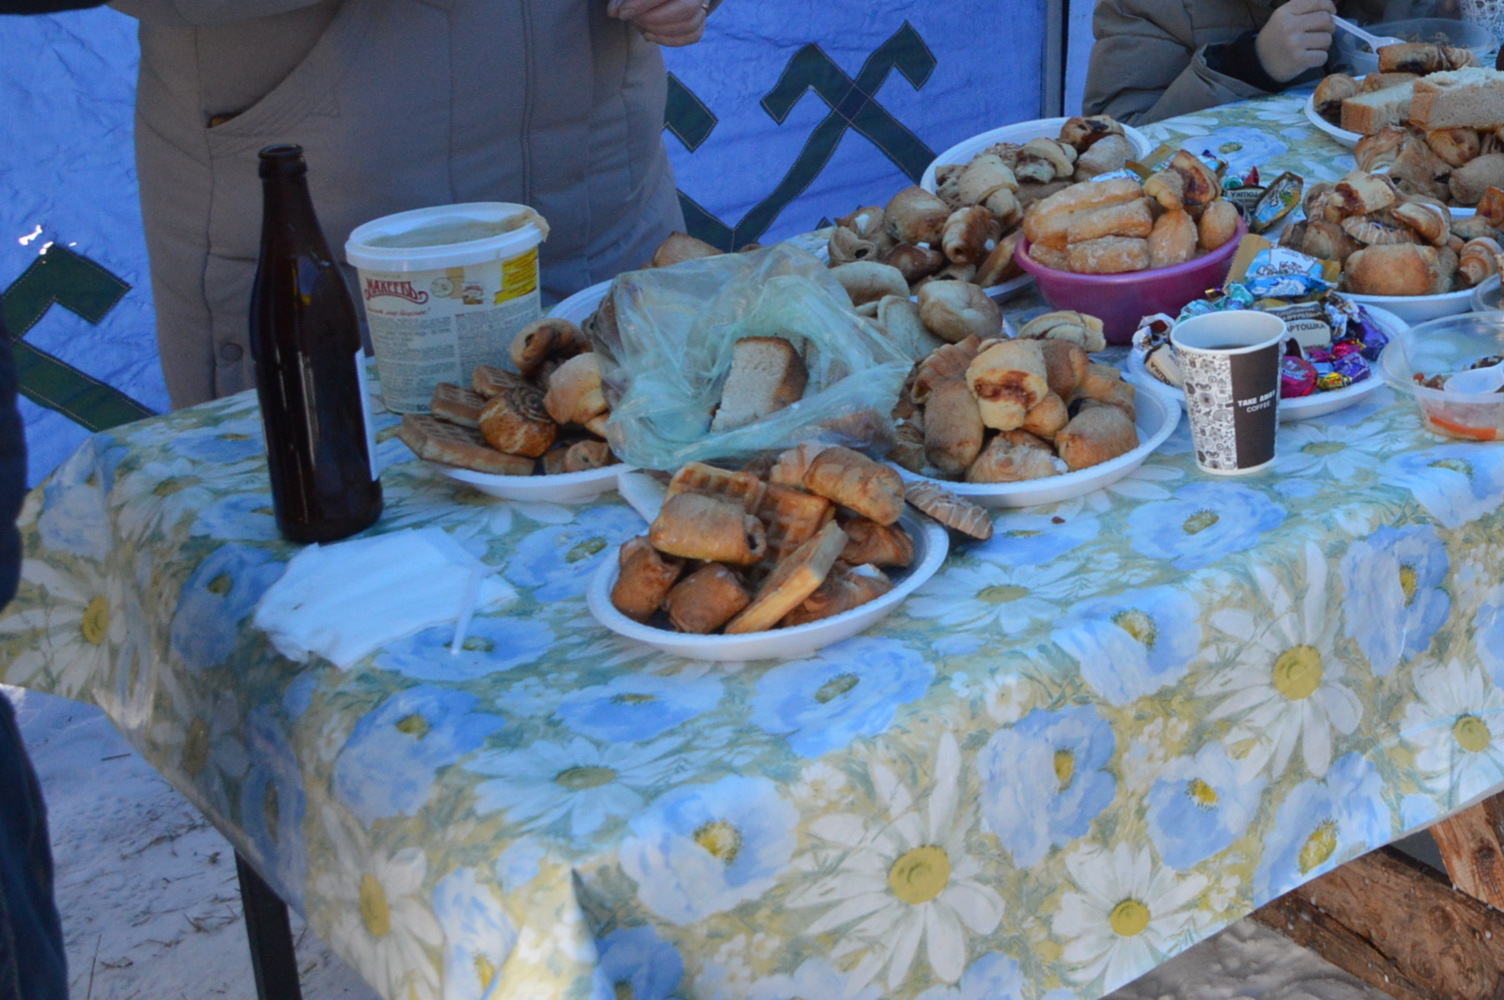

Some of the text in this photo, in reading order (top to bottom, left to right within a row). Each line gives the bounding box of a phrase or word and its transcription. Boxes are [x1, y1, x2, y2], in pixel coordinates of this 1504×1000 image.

[1286, 323, 1327, 332] АРТОШКА
[1237, 389, 1276, 407] TAKE AWAY
[1246, 401, 1271, 413] COFFEE
